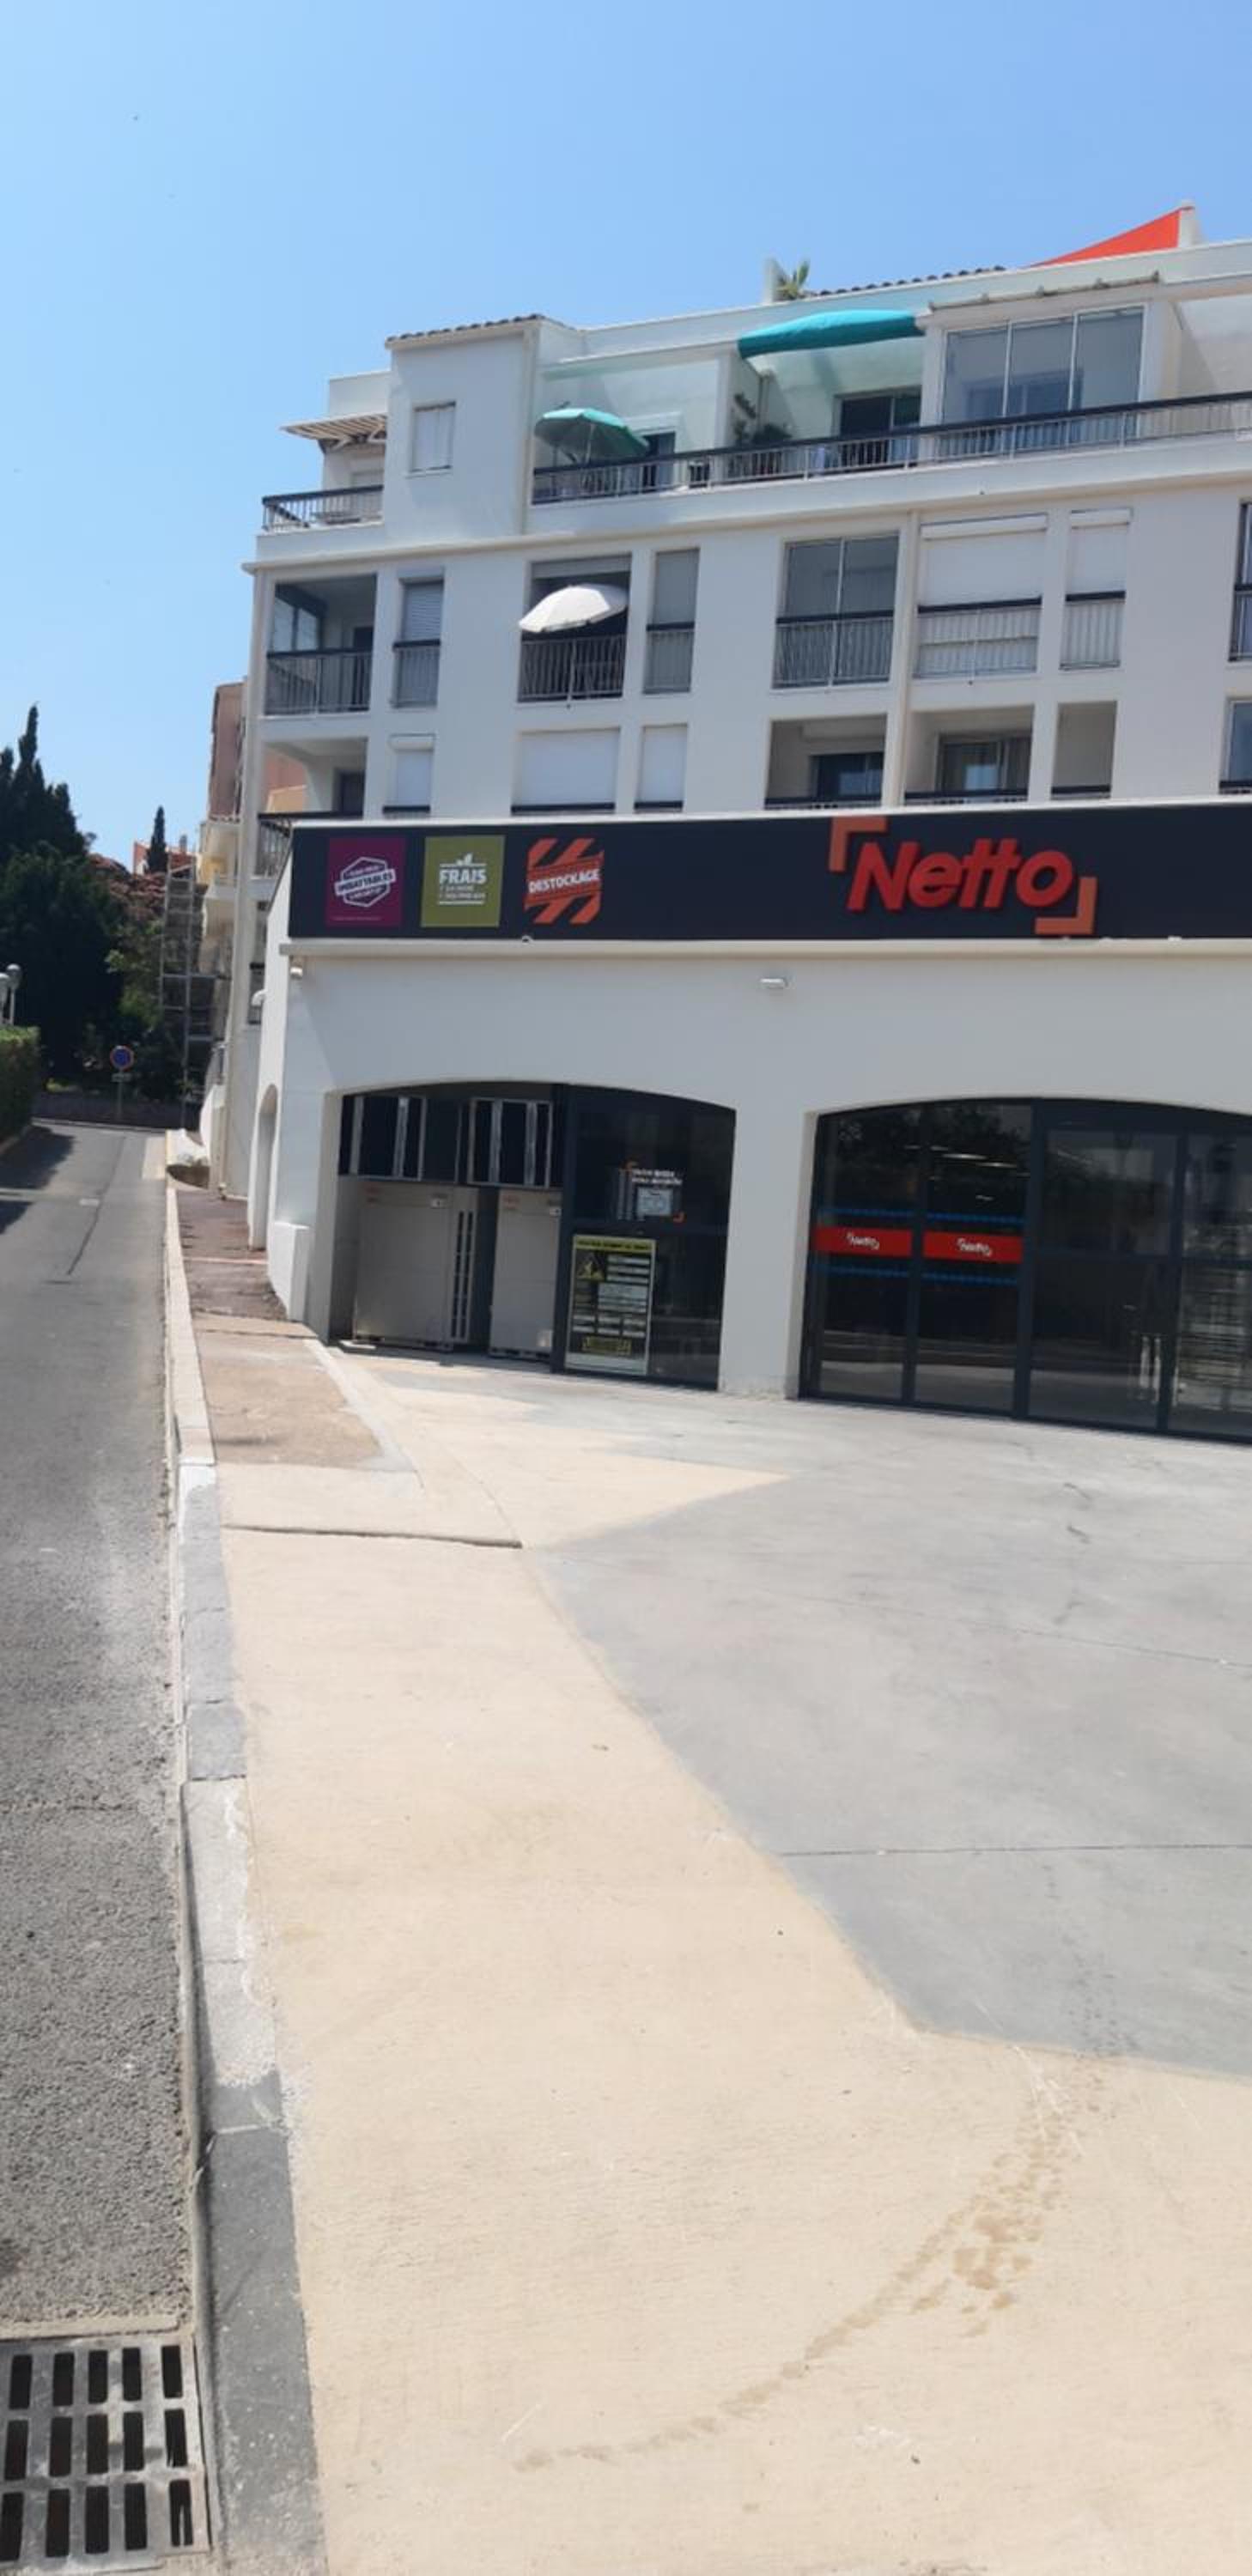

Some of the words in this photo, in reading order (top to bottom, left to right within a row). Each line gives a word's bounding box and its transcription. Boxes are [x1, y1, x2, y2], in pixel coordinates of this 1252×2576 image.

[439, 868, 487, 884] FRAIS
[528, 868, 600, 894] DESTOCKAGE
[848, 838, 1073, 911] Netto
